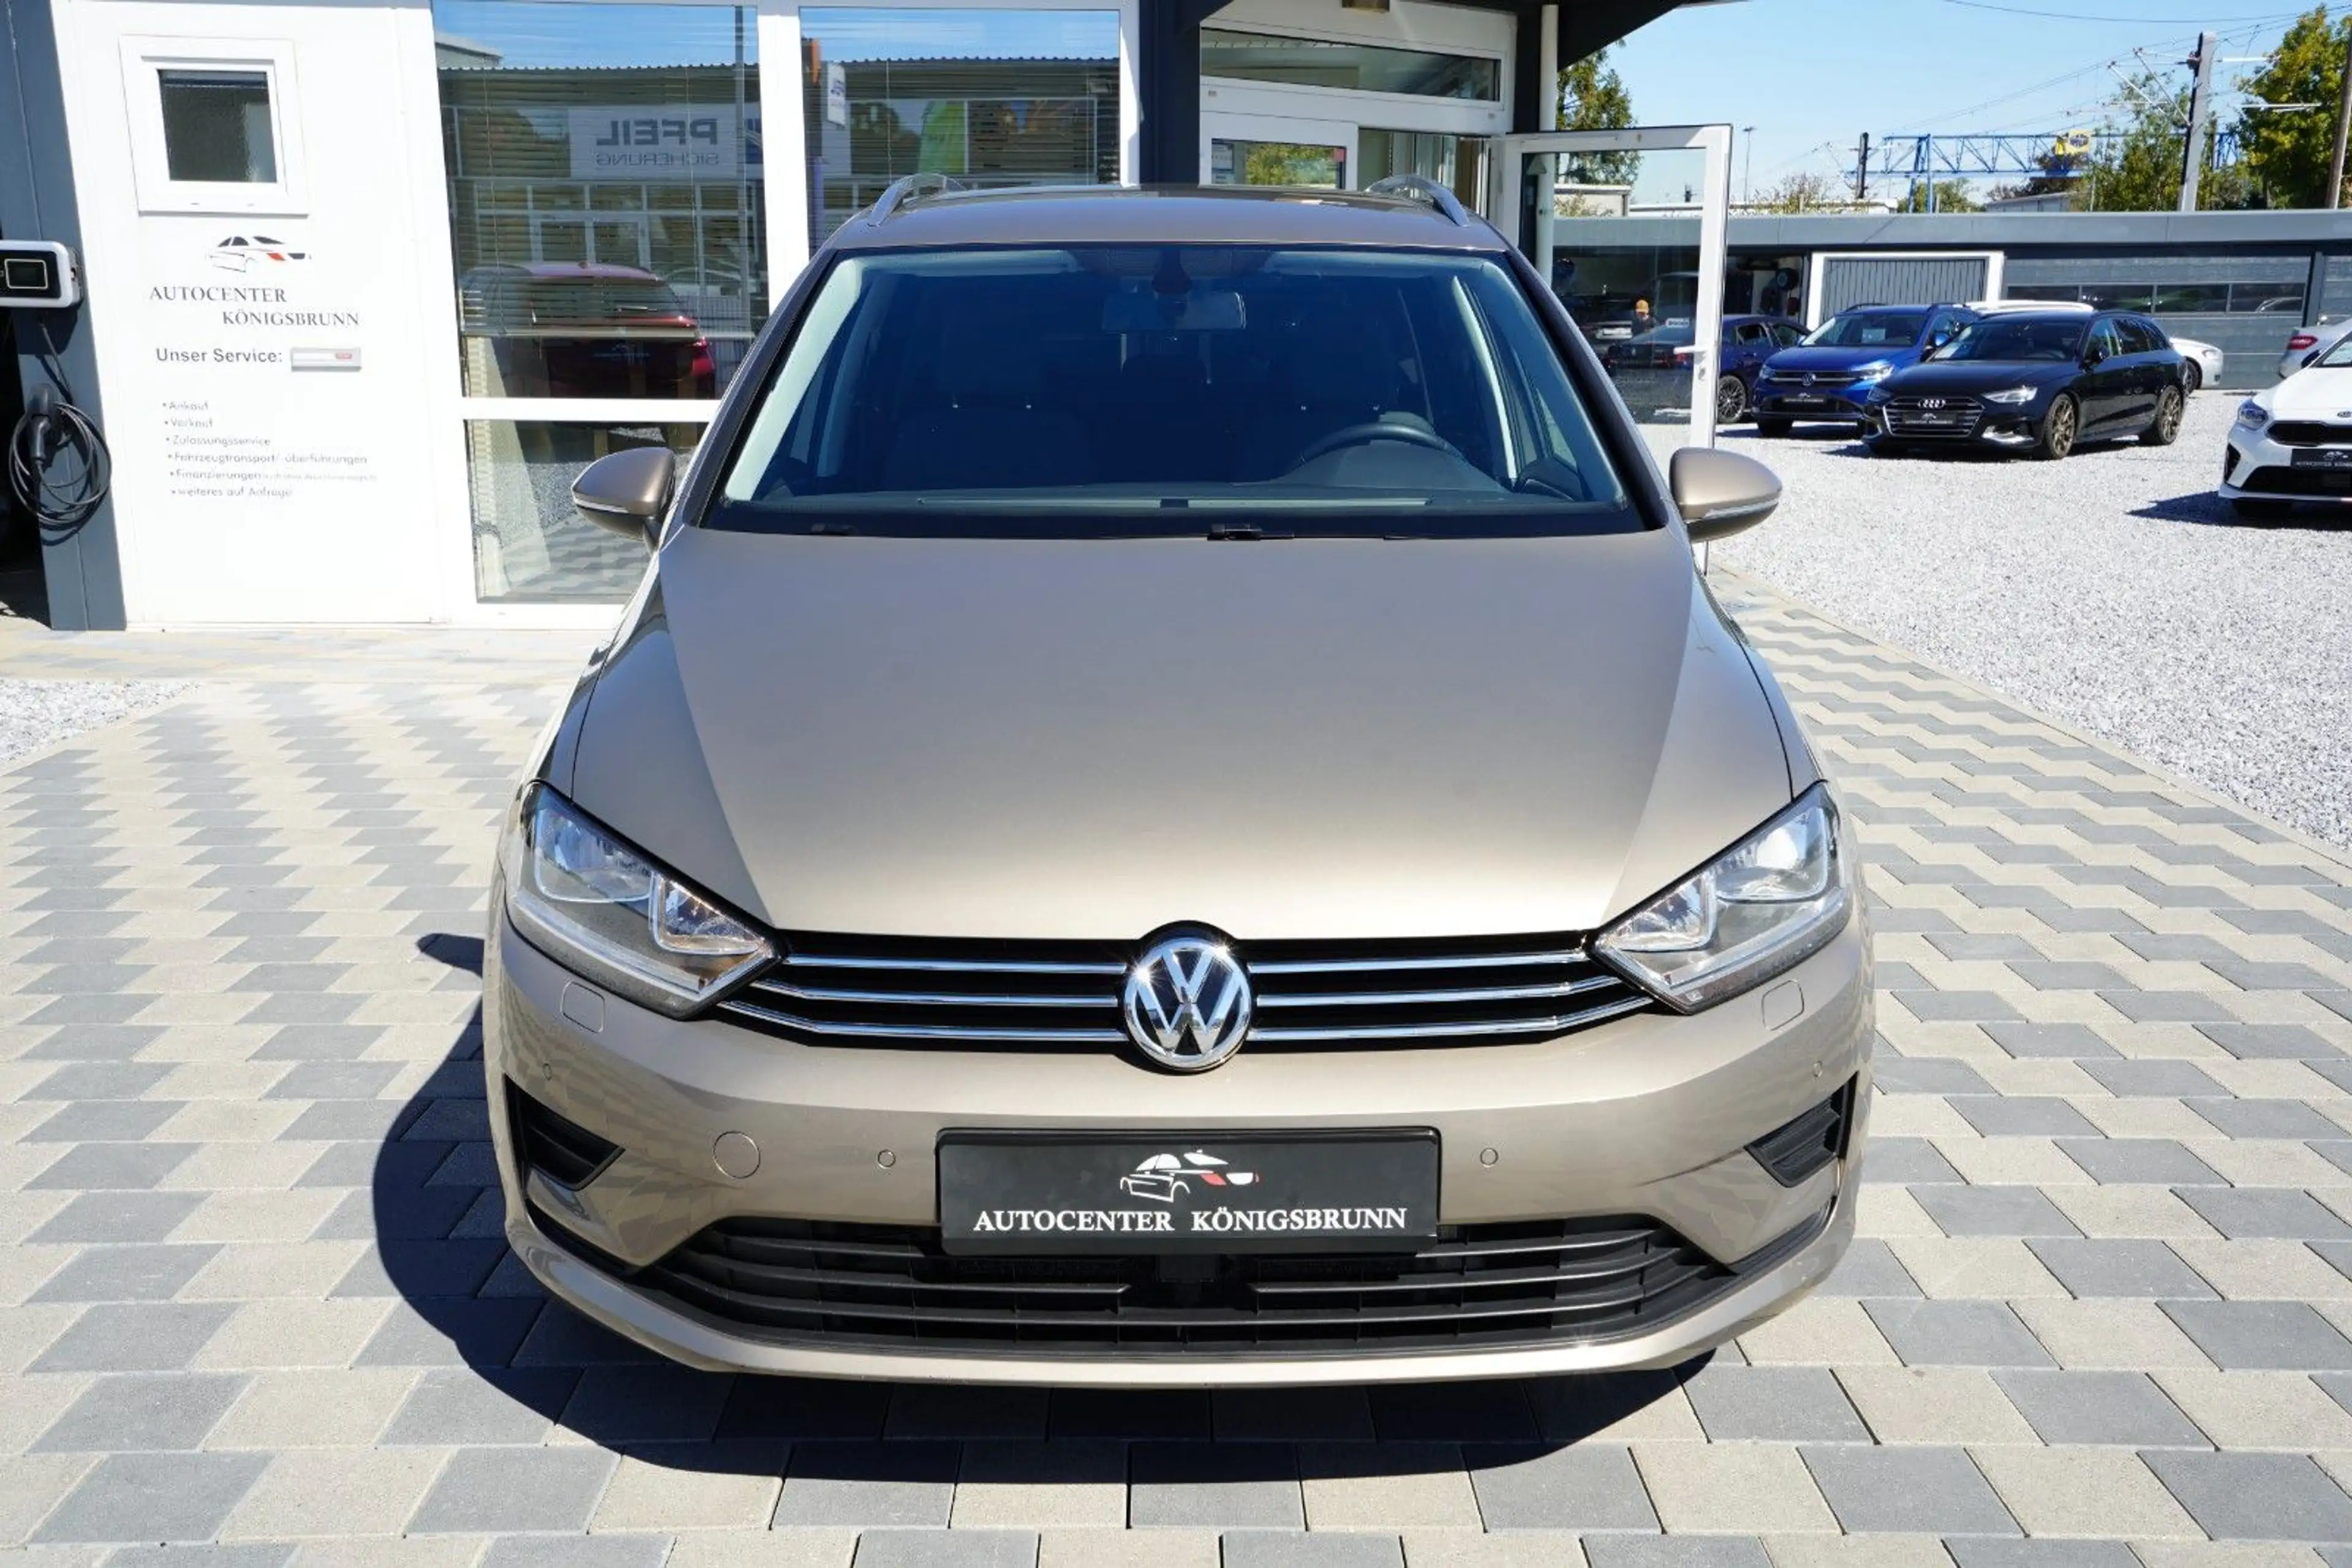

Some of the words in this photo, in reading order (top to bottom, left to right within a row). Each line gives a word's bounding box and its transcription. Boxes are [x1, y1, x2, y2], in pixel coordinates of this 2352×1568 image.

[149, 286, 287, 303] AUTOCENTER
[222, 309, 360, 326] KÖNIGSBRUNN
[156, 348, 207, 362] Unser
[213, 348, 282, 363] Service:
[973, 1209, 1175, 1232] AUTOCENTER
[1191, 1206, 1408, 1231] KÖNIGSBRUNN
